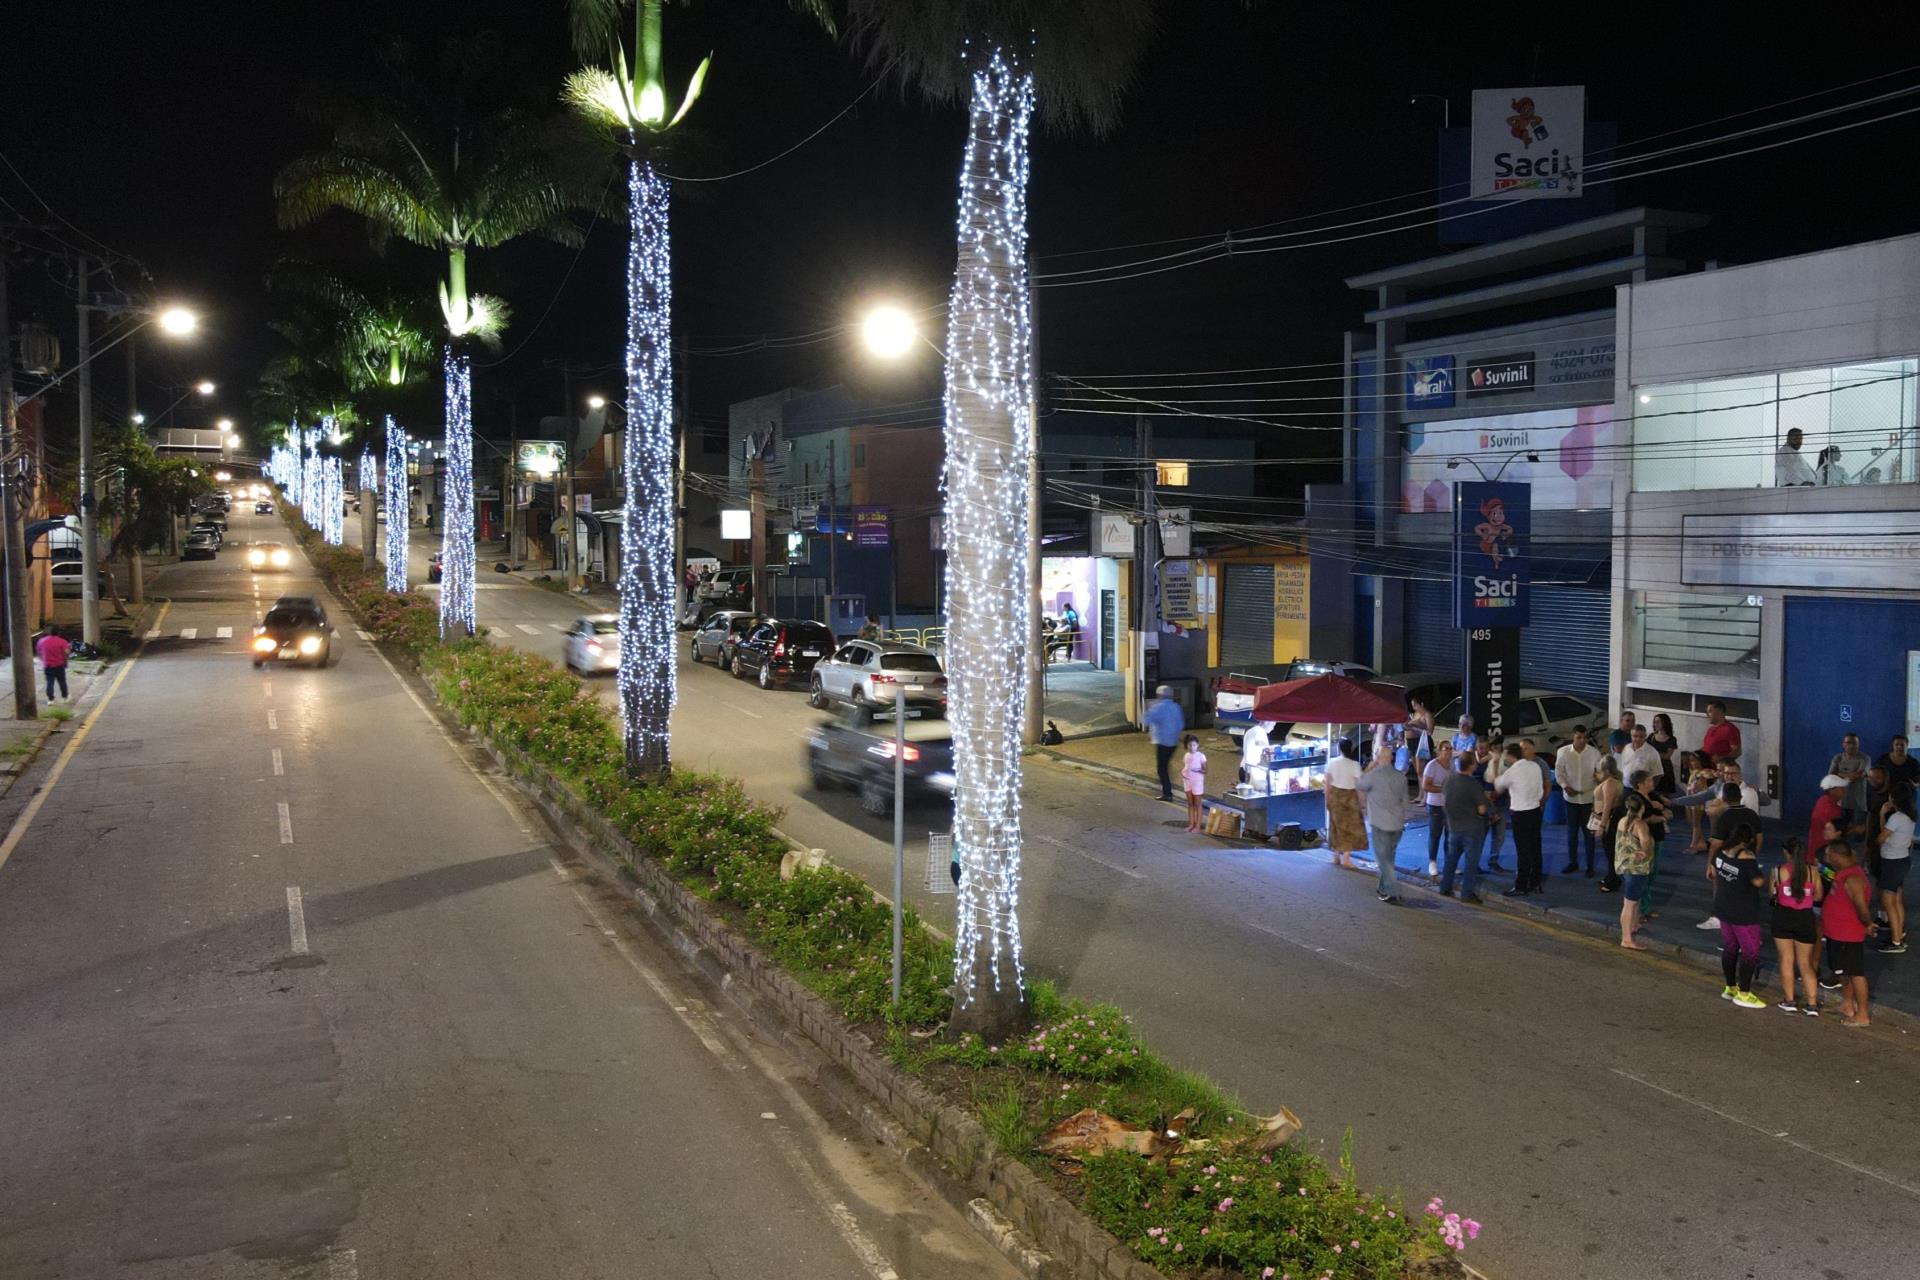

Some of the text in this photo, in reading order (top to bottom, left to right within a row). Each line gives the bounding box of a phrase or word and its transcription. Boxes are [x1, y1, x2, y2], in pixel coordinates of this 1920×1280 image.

[1494, 148, 1560, 178] Saci
[1485, 364, 1528, 386] Suvinil
[1490, 432, 1529, 448] Suvinil
[1712, 542, 1753, 558] POLO
[1758, 542, 1856, 558] ESPORTIVO
[1474, 574, 1518, 597] Saci
[1472, 629, 1491, 641] 495
[1487, 661, 1502, 738] Suvinil
